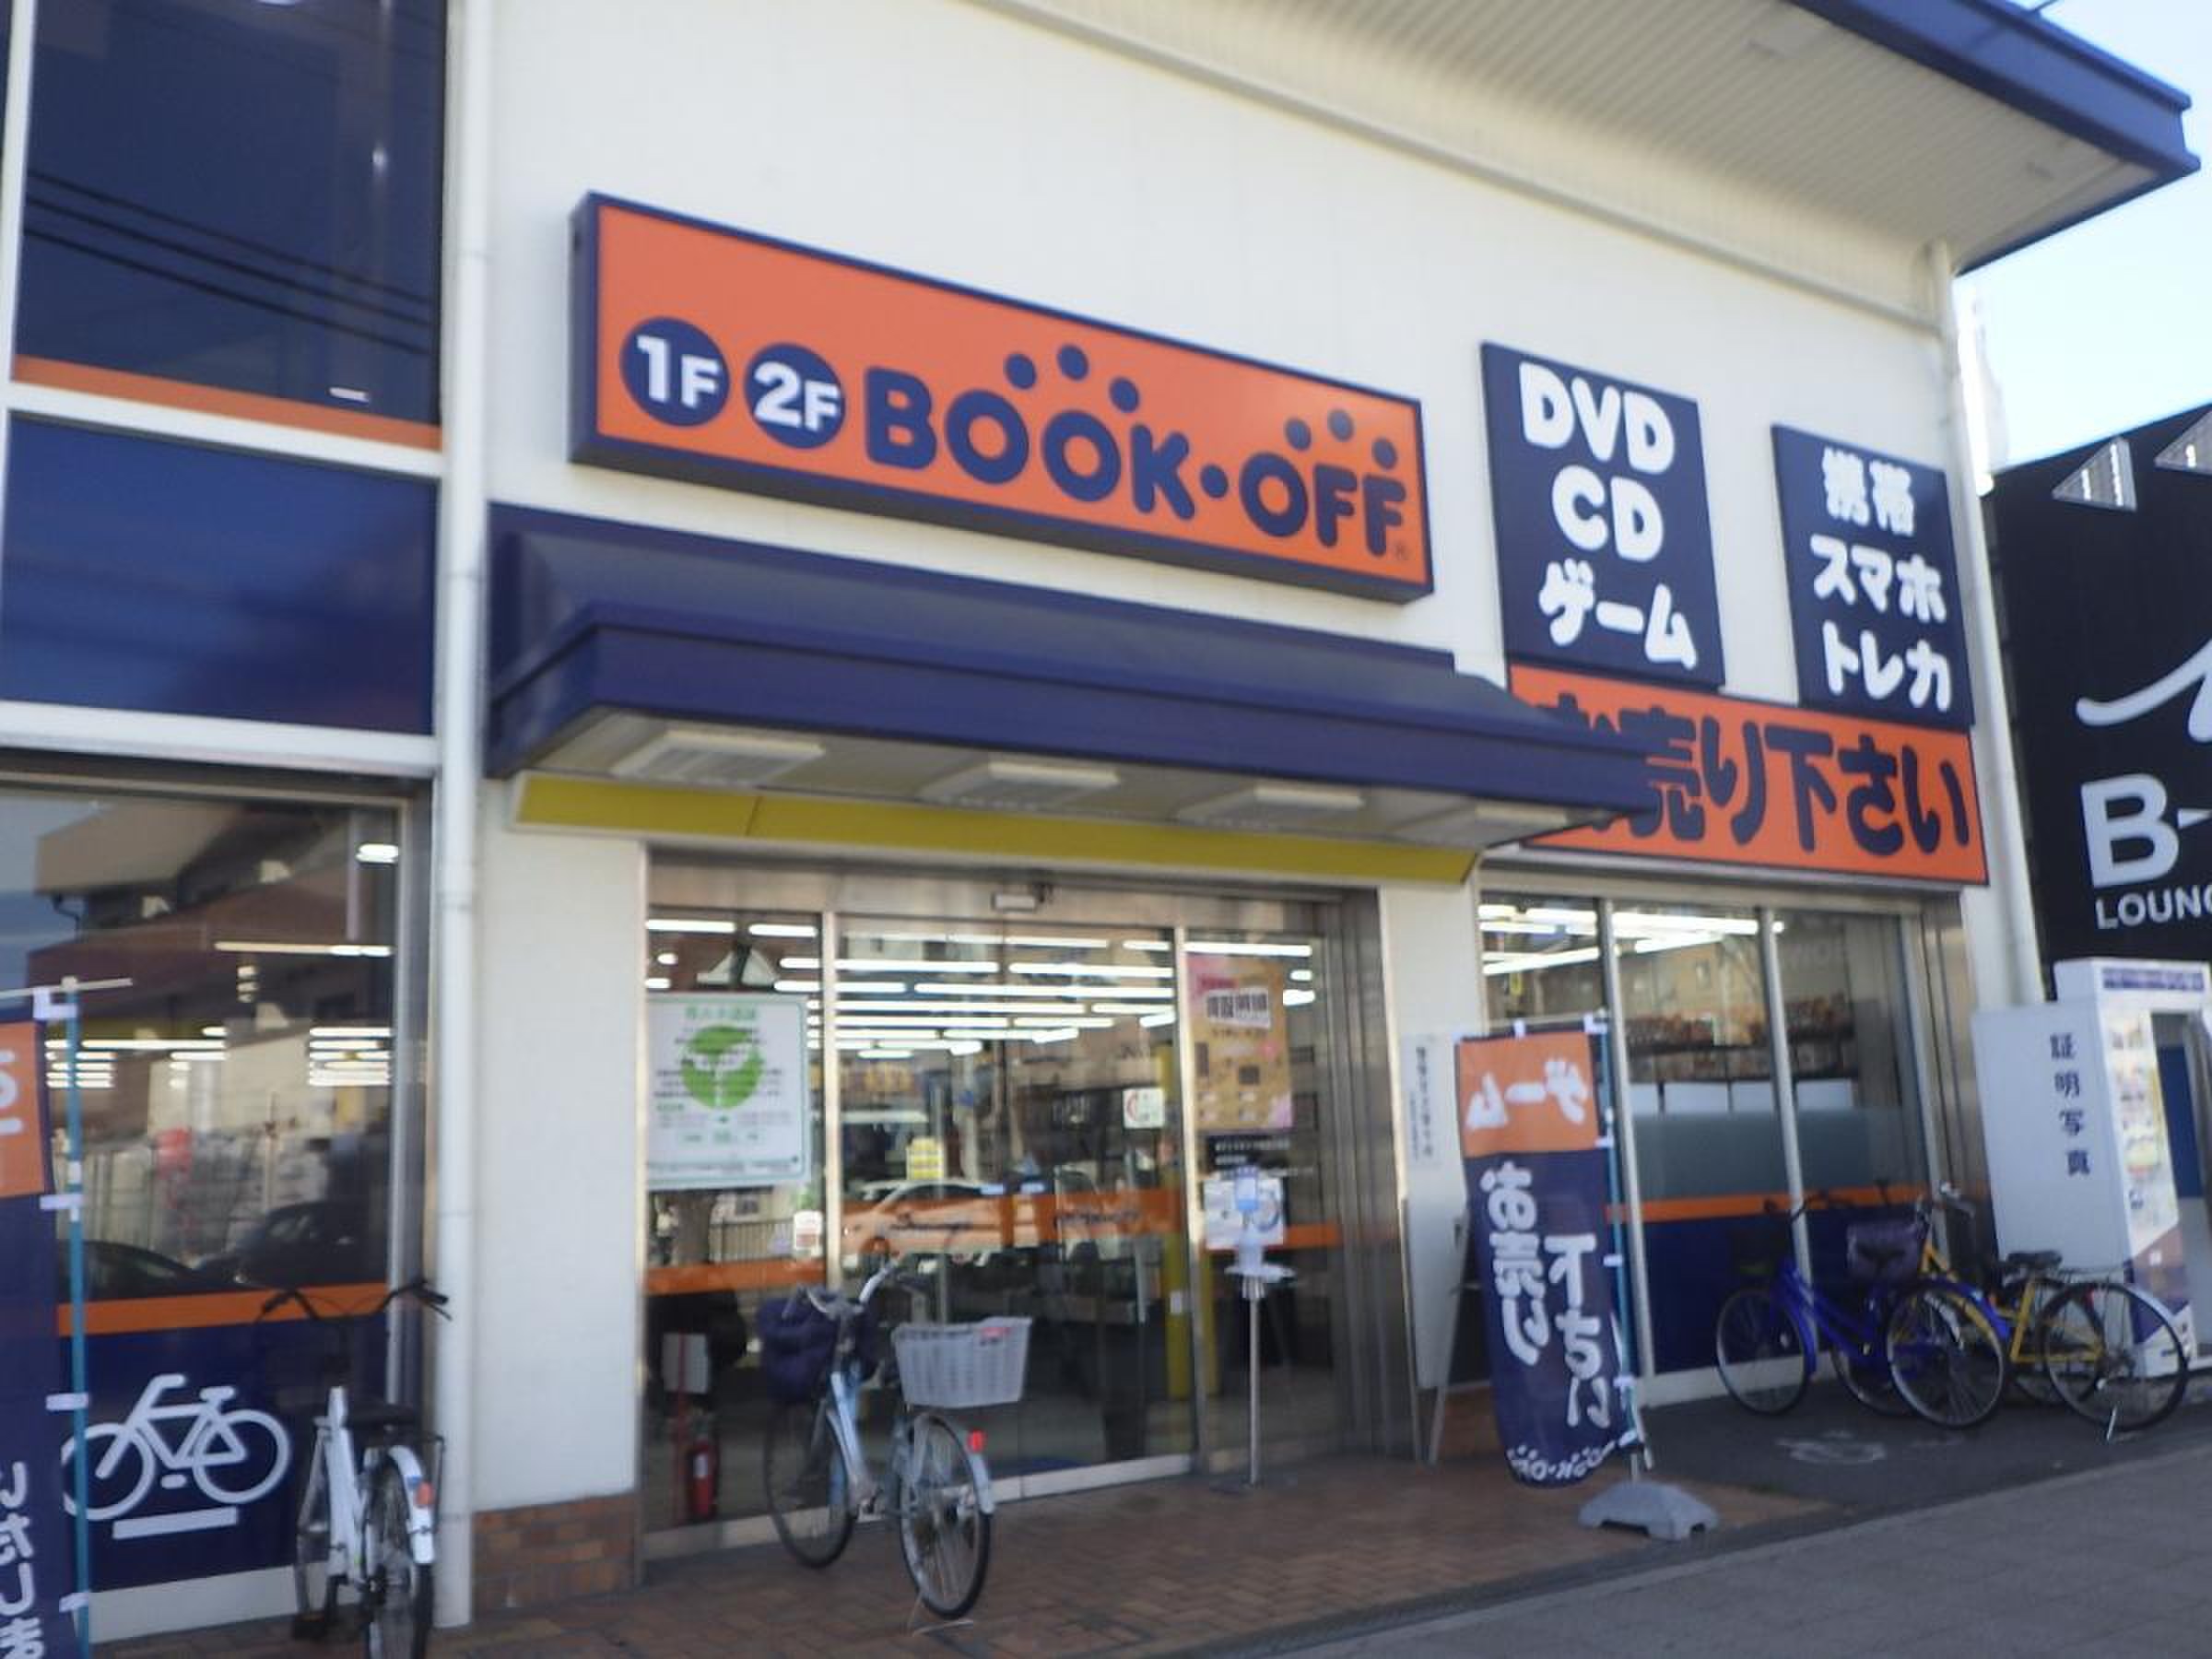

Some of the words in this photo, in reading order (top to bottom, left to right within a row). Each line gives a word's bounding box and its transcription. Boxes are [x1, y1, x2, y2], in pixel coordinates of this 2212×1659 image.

[637, 335, 721, 408] 1F
[754, 360, 840, 431] 2F
[1519, 361, 1676, 474] DVD
[1551, 465, 1664, 562] CD
[1821, 447, 1914, 536] 携帯
[1538, 559, 1697, 668] ゲーム
[1810, 534, 1947, 622] スマホ
[1822, 620, 1951, 712] トレカ
[1536, 693, 1969, 856] 売り下さい
[2095, 883, 2212, 930] LOUN
[2049, 1033, 2090, 1177] 証明写真
